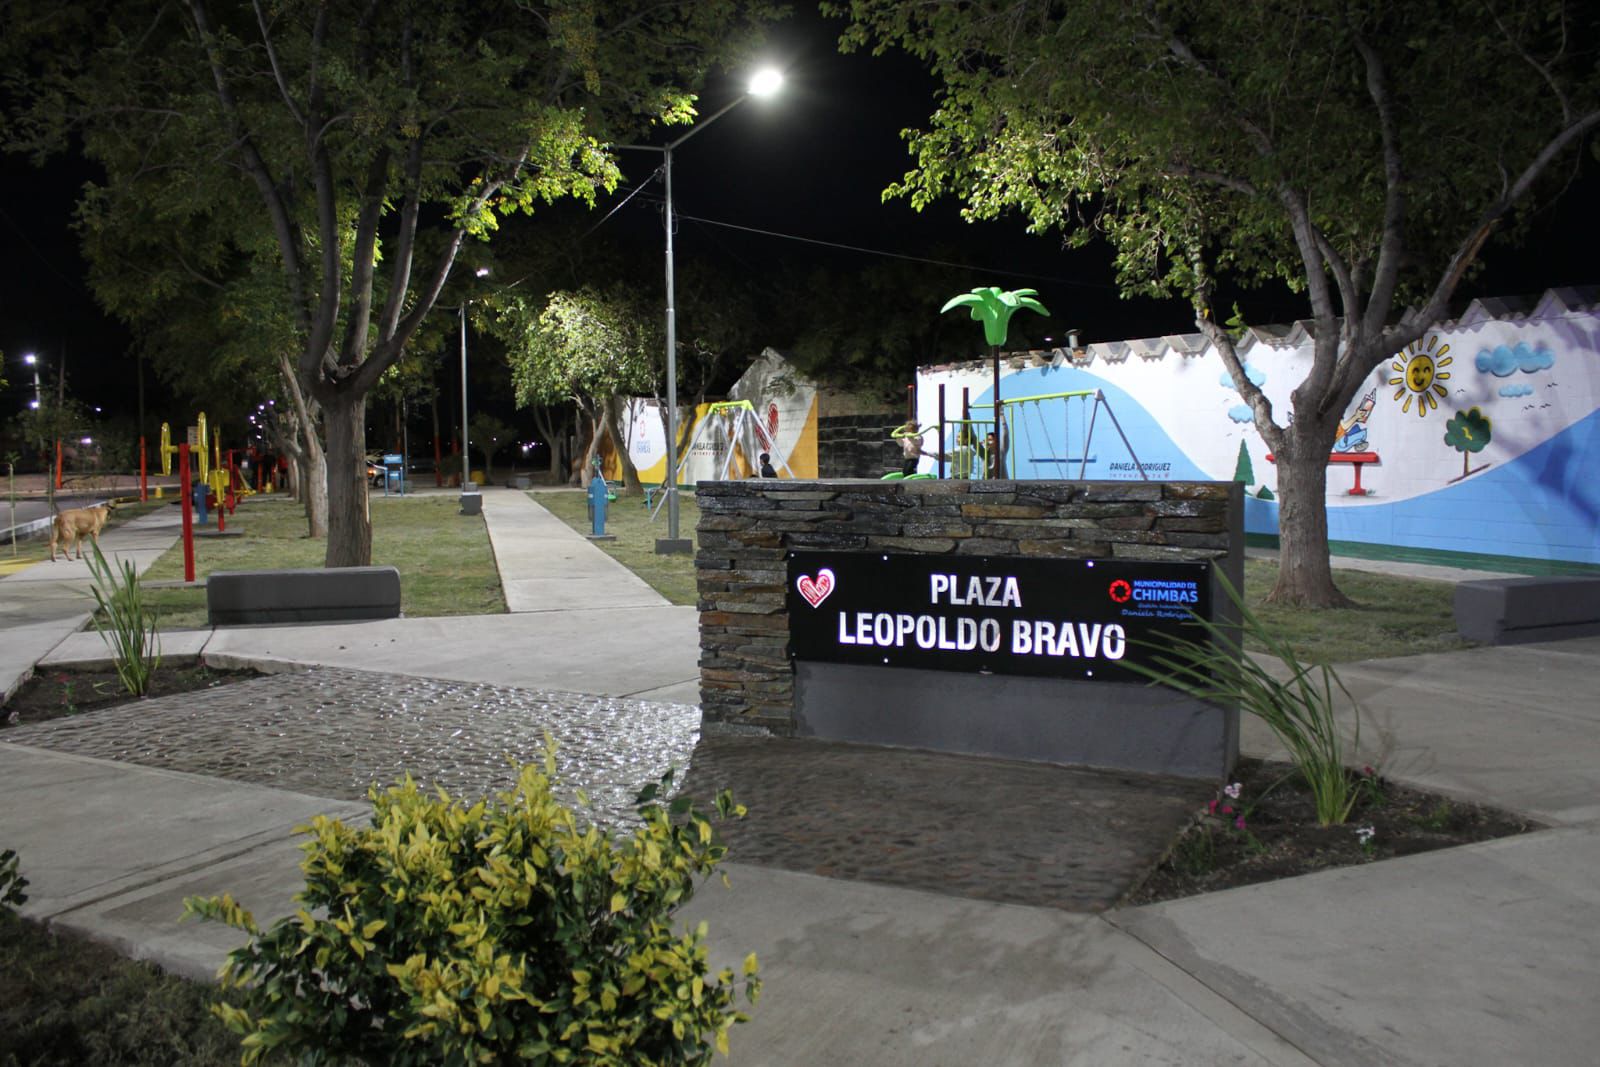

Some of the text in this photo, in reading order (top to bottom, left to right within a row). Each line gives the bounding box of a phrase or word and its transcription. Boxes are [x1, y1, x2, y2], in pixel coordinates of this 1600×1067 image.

[1110, 462, 1170, 471] DANIELA ODRIGUEZ
[930, 573, 1022, 608] PLAZA
[1134, 580, 1186, 588] MUNICIPALIDAD
[1132, 588, 1198, 602] CHIMBAS
[839, 612, 1126, 660] LEOPOLDO BRAVO
